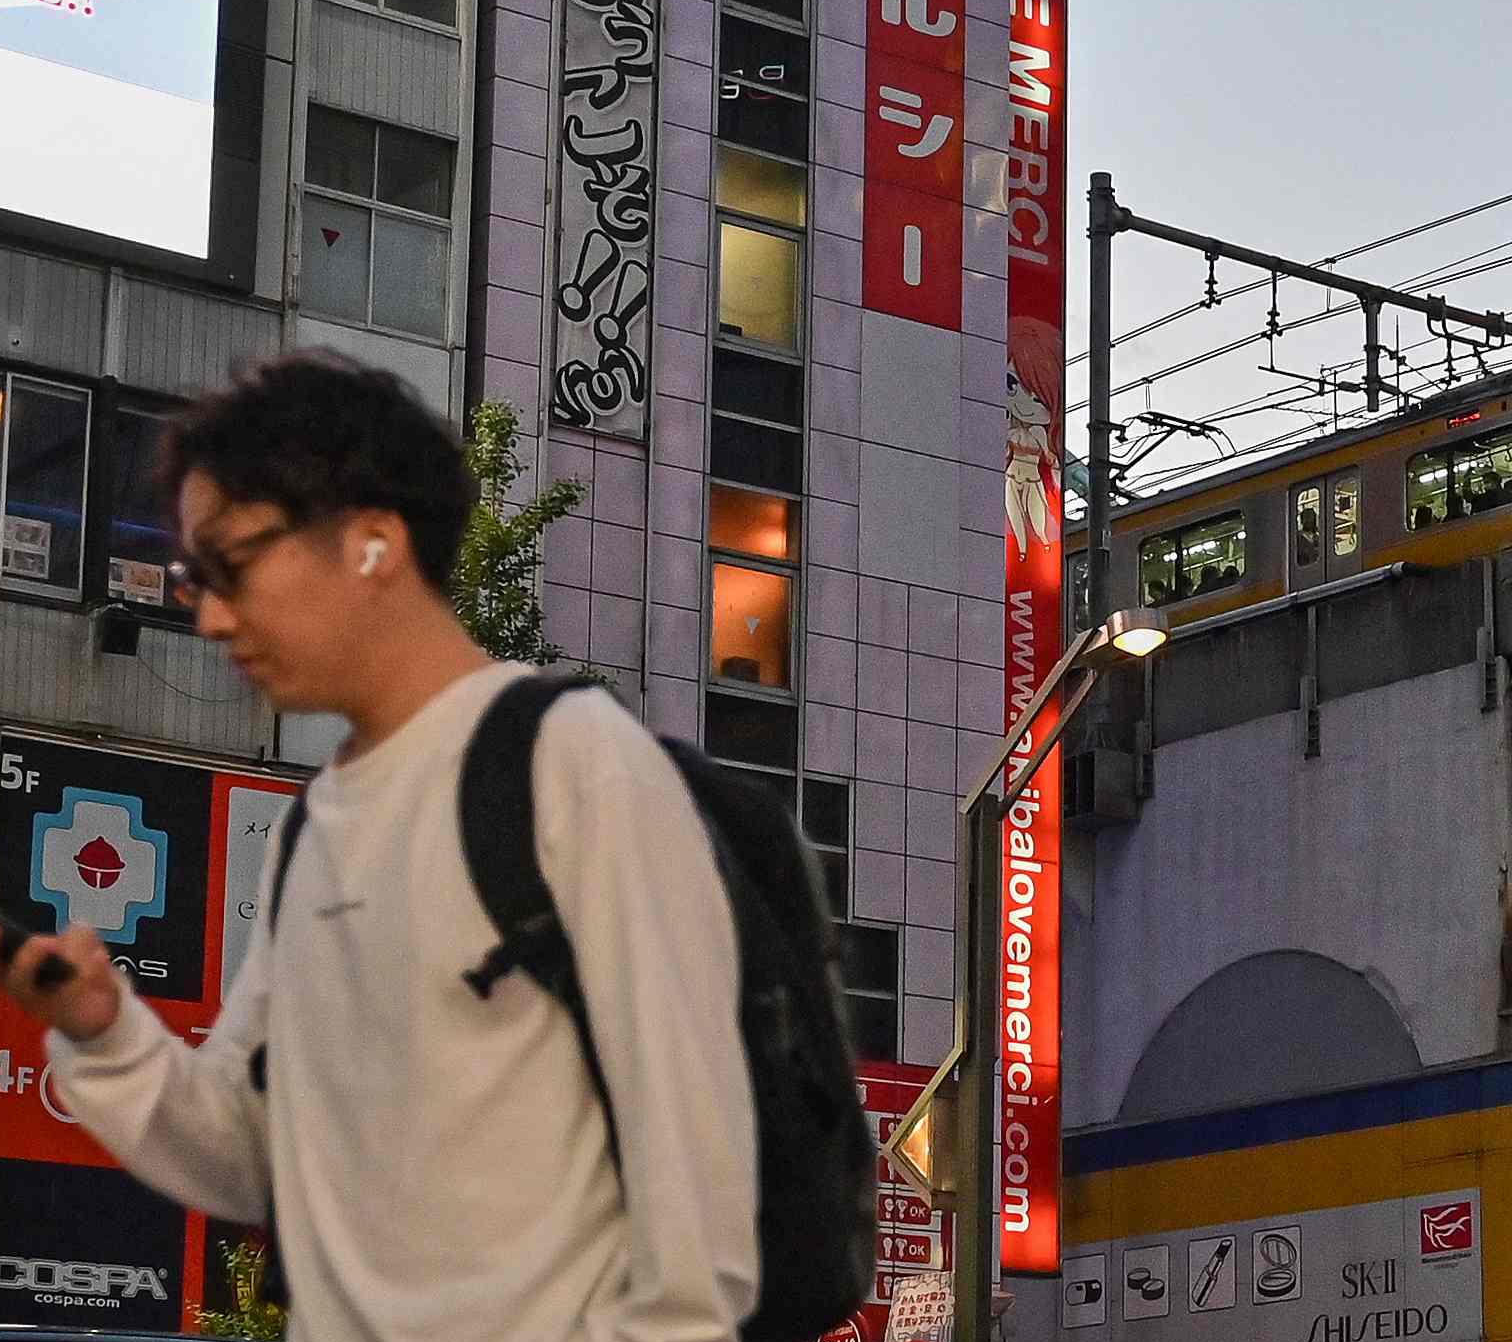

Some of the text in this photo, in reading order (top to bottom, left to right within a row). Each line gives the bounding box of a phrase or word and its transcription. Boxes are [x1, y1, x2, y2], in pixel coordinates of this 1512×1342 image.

[1005, 41, 1050, 267] MERCI
[0, 752, 41, 794] 5F
[908, 1244, 925, 1256] OK
[1341, 1259, 1398, 1297] SK-II
[33, 1291, 122, 1312] cospa.com
